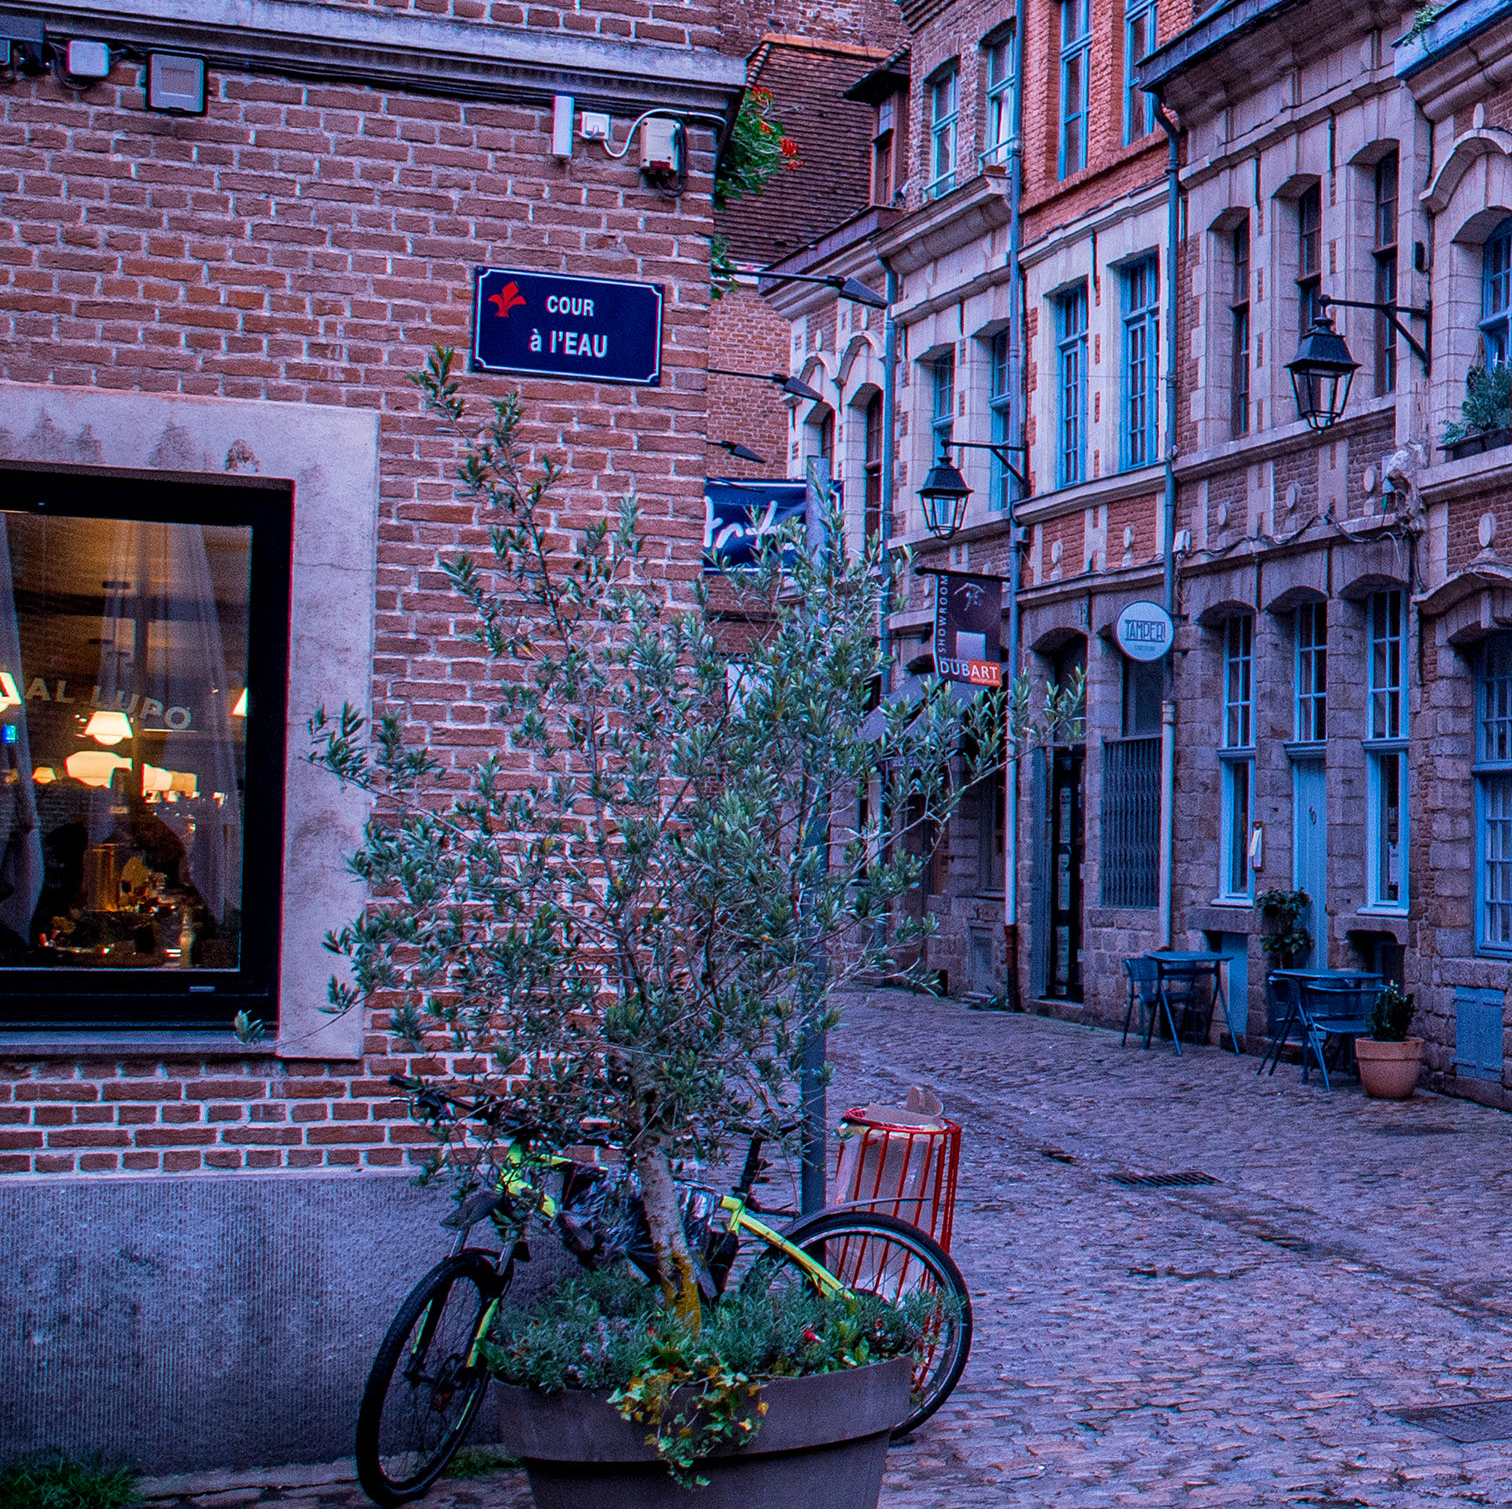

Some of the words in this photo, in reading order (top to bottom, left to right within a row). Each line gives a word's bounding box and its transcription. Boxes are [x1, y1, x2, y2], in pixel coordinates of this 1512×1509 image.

[545, 295, 595, 317] COUR
[528, 328, 542, 352] à
[550, 330, 608, 358] l'EAU
[938, 575, 949, 653] SHOWROOM
[24, 677, 76, 704] AL
